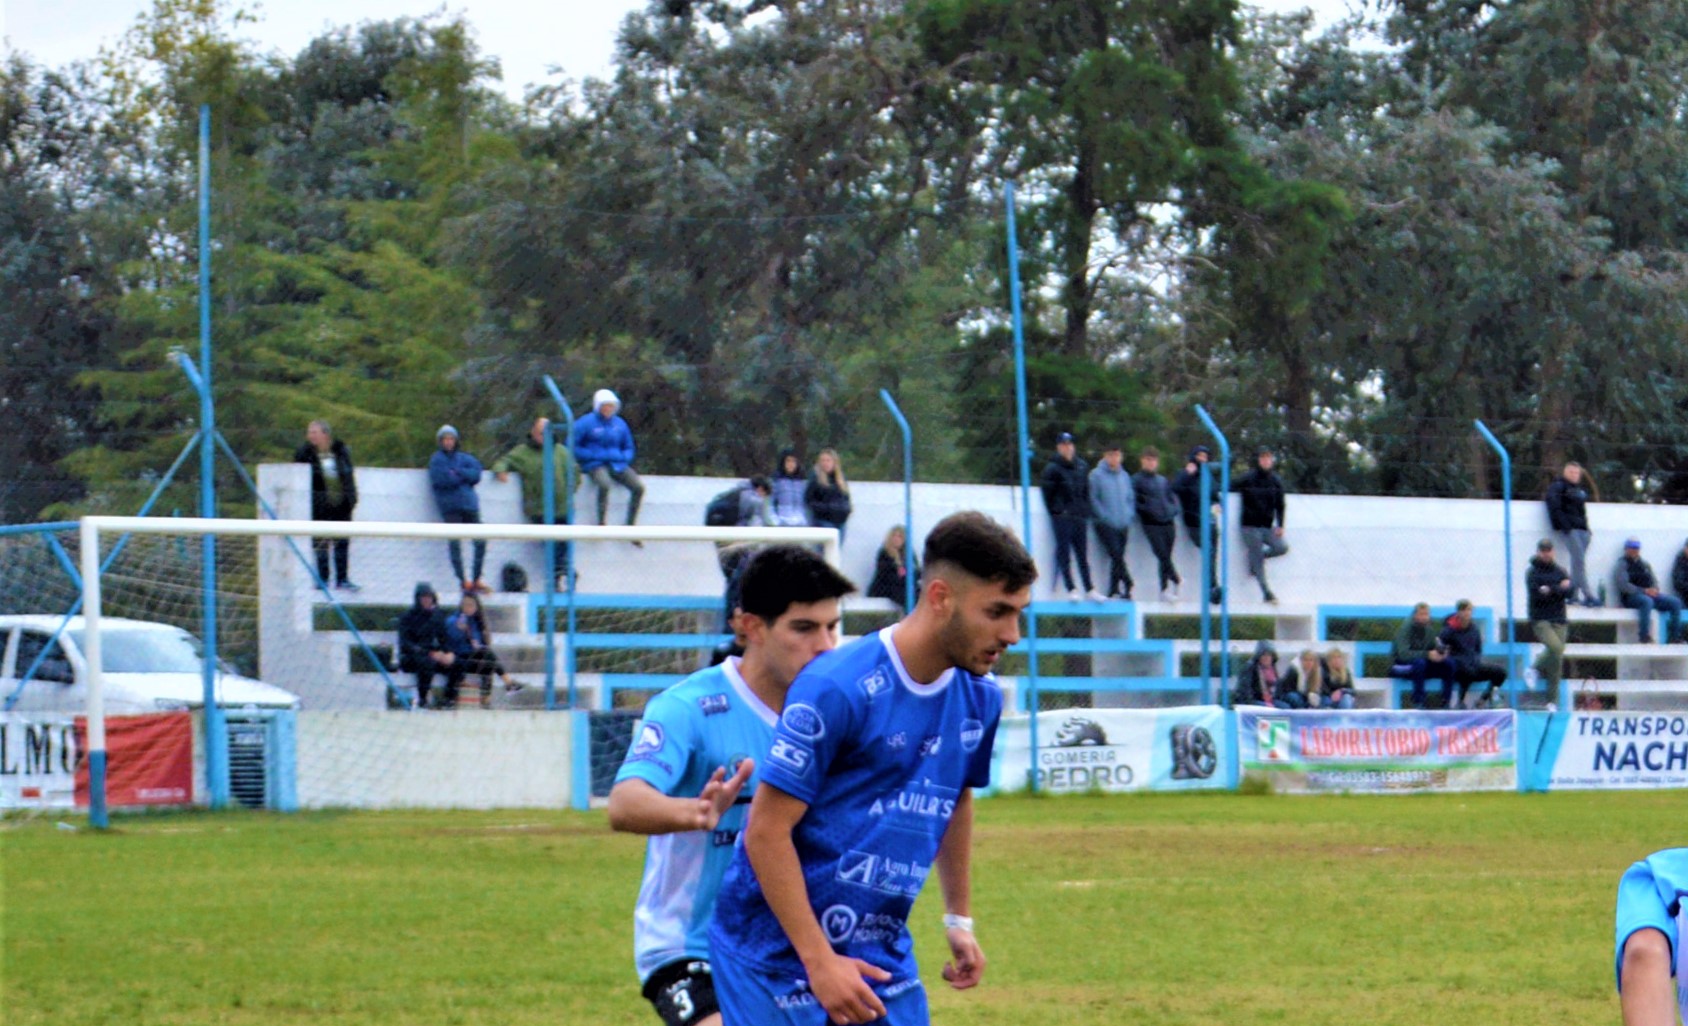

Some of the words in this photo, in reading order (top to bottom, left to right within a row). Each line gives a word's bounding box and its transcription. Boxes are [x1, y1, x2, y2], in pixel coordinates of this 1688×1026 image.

[1300, 726, 1431, 757] LABORATORIO
[1041, 750, 1117, 765] GOMERIA
[1026, 764, 1134, 788] PEDRO
[672, 988, 694, 1021] 3
